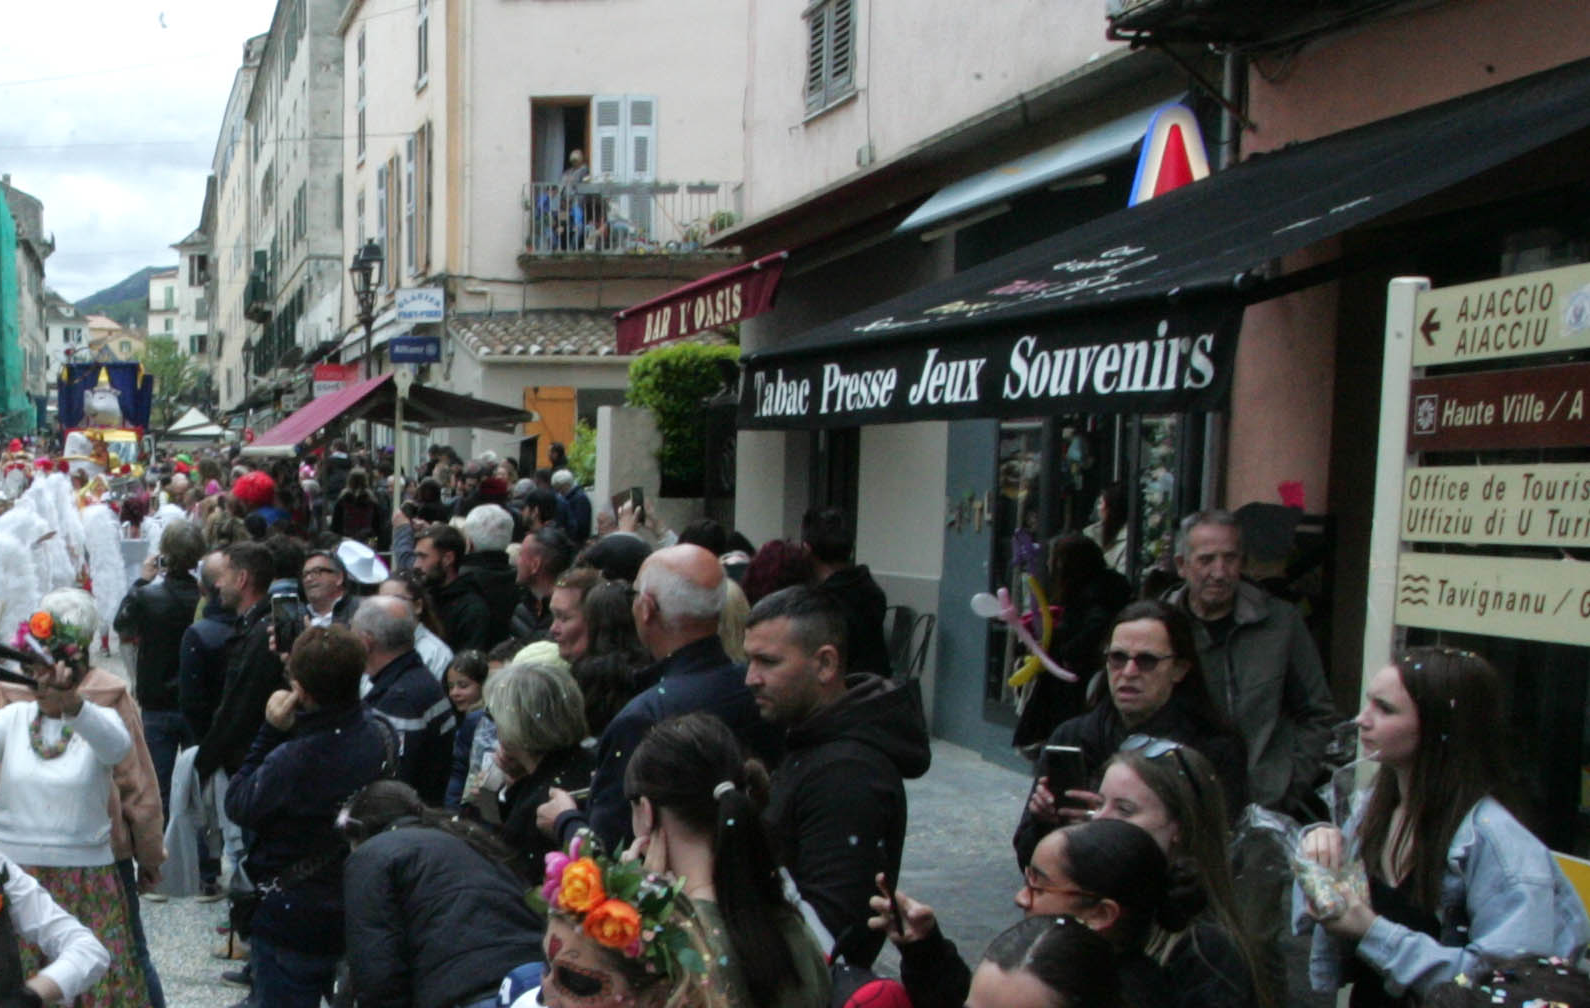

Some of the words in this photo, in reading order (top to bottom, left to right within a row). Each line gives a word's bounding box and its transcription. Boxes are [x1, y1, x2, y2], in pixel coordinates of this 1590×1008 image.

[642, 305, 672, 344] BAR
[678, 282, 743, 335] L'OASIS
[1456, 282, 1554, 323] AJACCIO
[1454, 317, 1550, 357] AIACCIU
[753, 367, 810, 418] Tabac
[819, 361, 898, 415] Presse
[909, 347, 987, 405] Jeux
[1002, 319, 1215, 400] Souvenirs
[1441, 398, 1495, 427] Haute
[1502, 393, 1544, 423] Ville
[1547, 391, 1568, 421] /
[1568, 390, 1584, 421] A
[1408, 474, 1470, 501] Office
[1482, 474, 1507, 501] de
[1406, 507, 1473, 535] Uffiziu
[1485, 509, 1507, 536] di
[1517, 508, 1533, 537] U
[1436, 578, 1547, 618] Tavignanu
[1552, 587, 1575, 616] /
